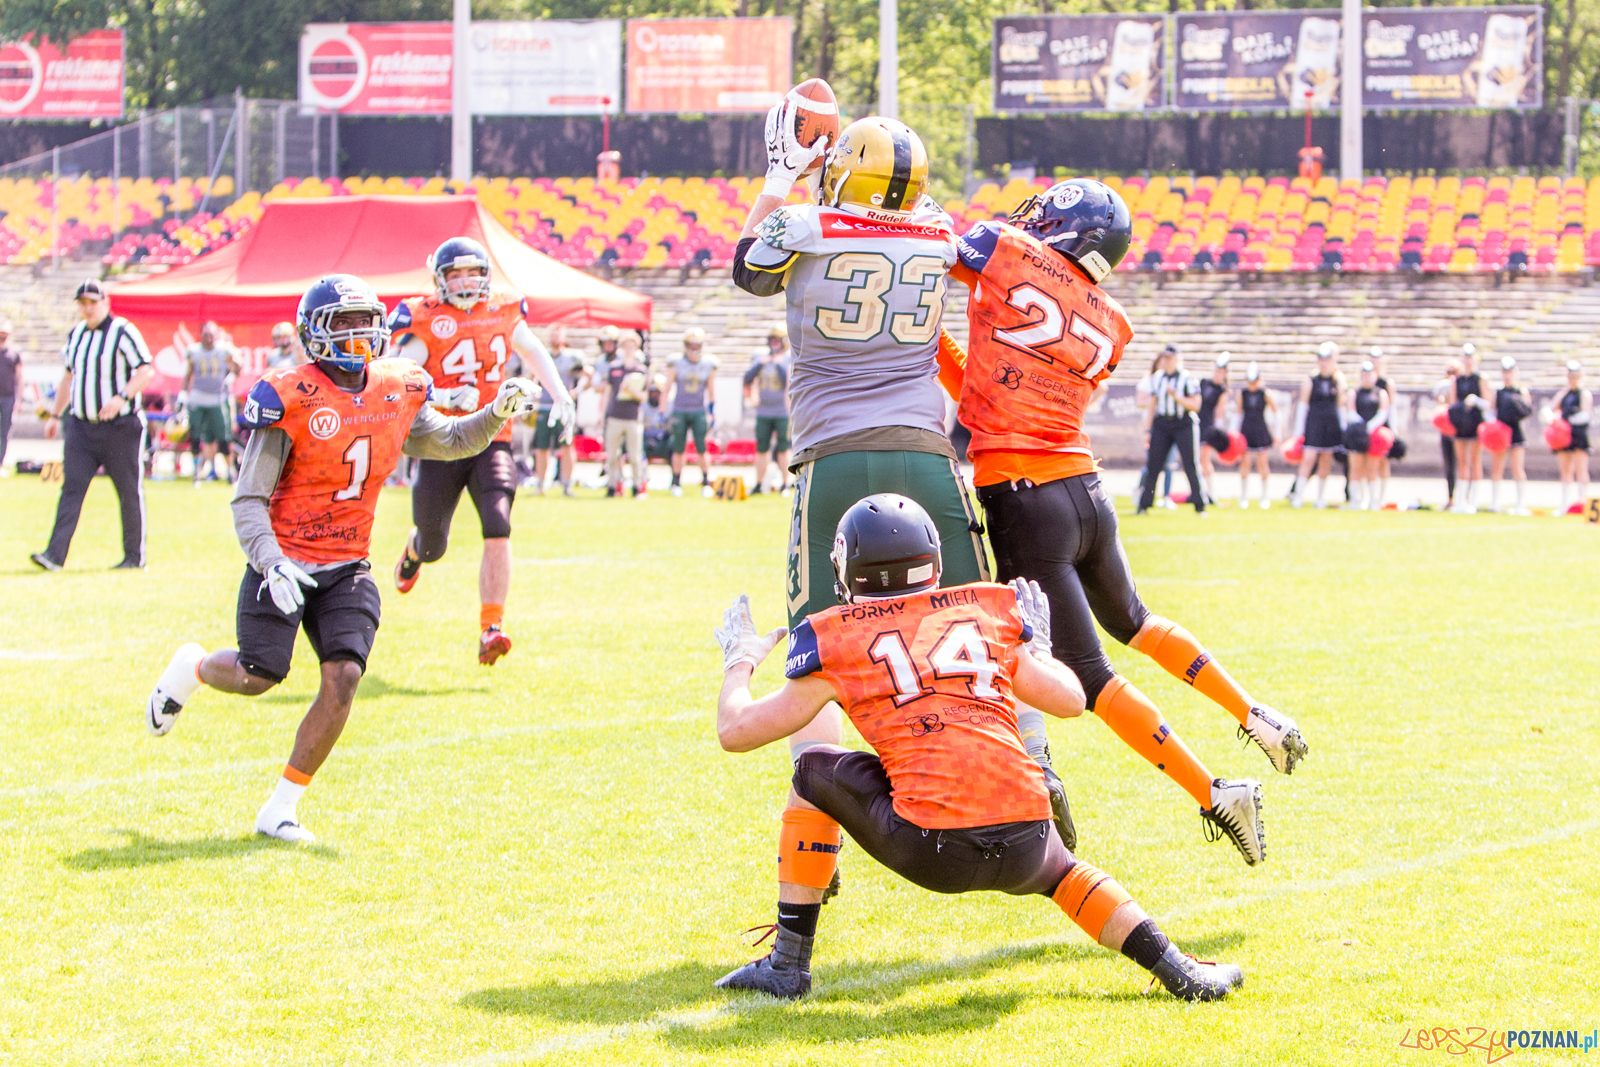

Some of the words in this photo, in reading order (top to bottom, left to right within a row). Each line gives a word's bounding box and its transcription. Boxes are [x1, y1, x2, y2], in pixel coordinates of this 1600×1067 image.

[45, 56, 120, 77] reklama
[370, 51, 451, 73] reklama
[1022, 248, 1073, 287] FORMY
[814, 251, 947, 345] 33
[992, 281, 1116, 380] 27
[440, 333, 507, 384] 41
[685, 371, 700, 394] 3
[331, 435, 372, 503] 1
[716, 477, 738, 500] 40
[841, 602, 906, 623] FORMY
[929, 589, 979, 609] MIETA
[867, 620, 1004, 709] 14
